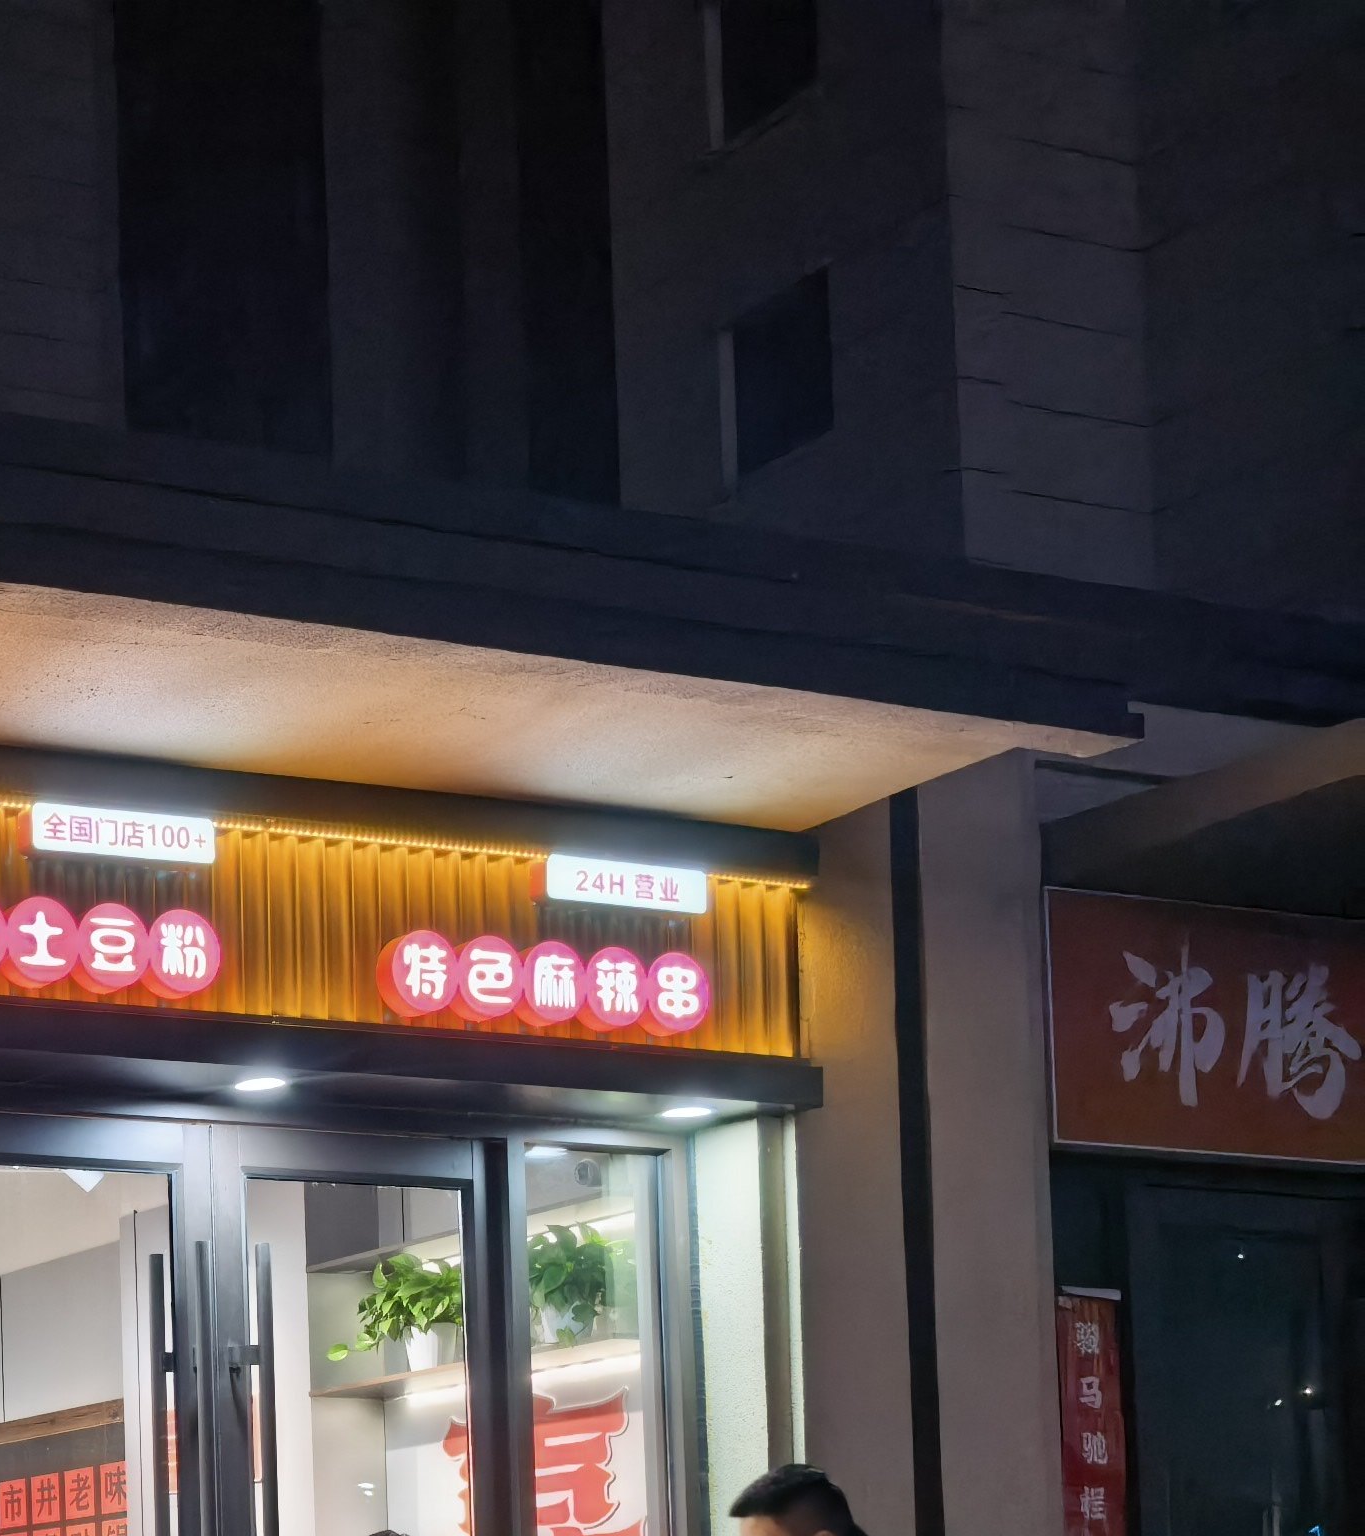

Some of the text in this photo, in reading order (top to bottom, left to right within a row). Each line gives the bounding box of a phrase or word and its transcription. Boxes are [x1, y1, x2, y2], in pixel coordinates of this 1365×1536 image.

[43, 812, 207, 850] 全国门店100+
[575, 869, 680, 903] 24H 营业
[403, 943, 699, 1018] 特色麻辣串
[1109, 931, 1362, 1120] 沸腾
